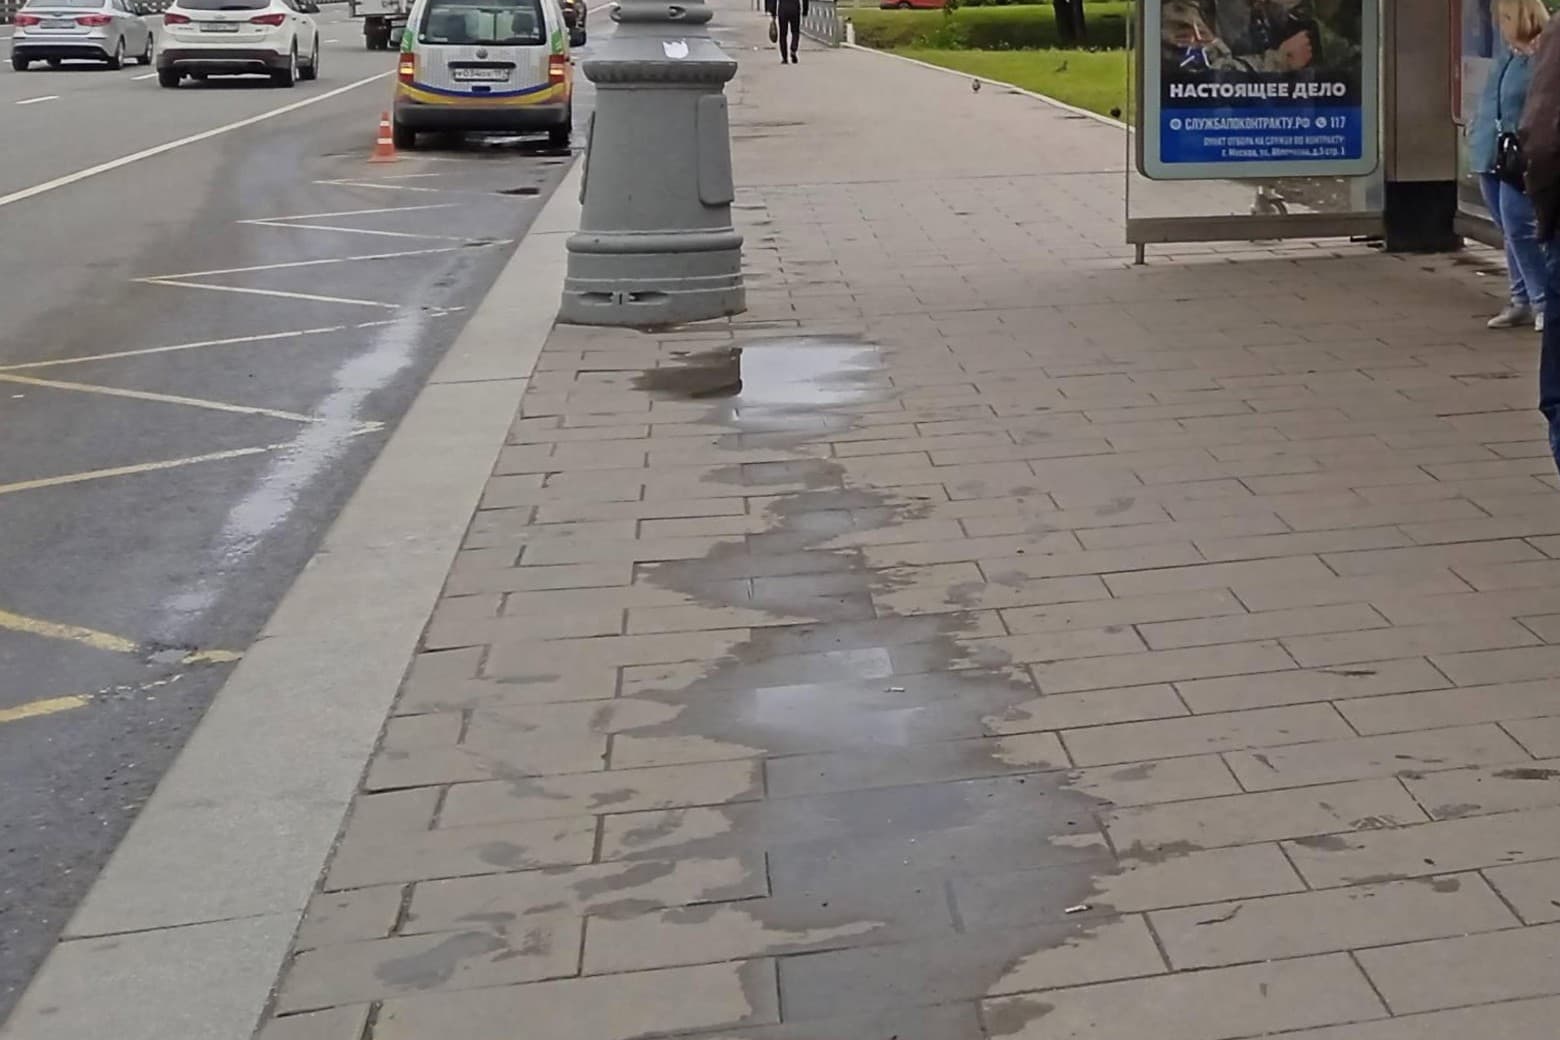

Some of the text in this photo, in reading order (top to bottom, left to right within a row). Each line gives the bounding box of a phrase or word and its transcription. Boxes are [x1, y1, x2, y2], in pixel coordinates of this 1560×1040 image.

[1170, 82, 1347, 100] НАСТОЯЩЕЕ ДЕЛО
[1331, 116, 1346, 129] 117
